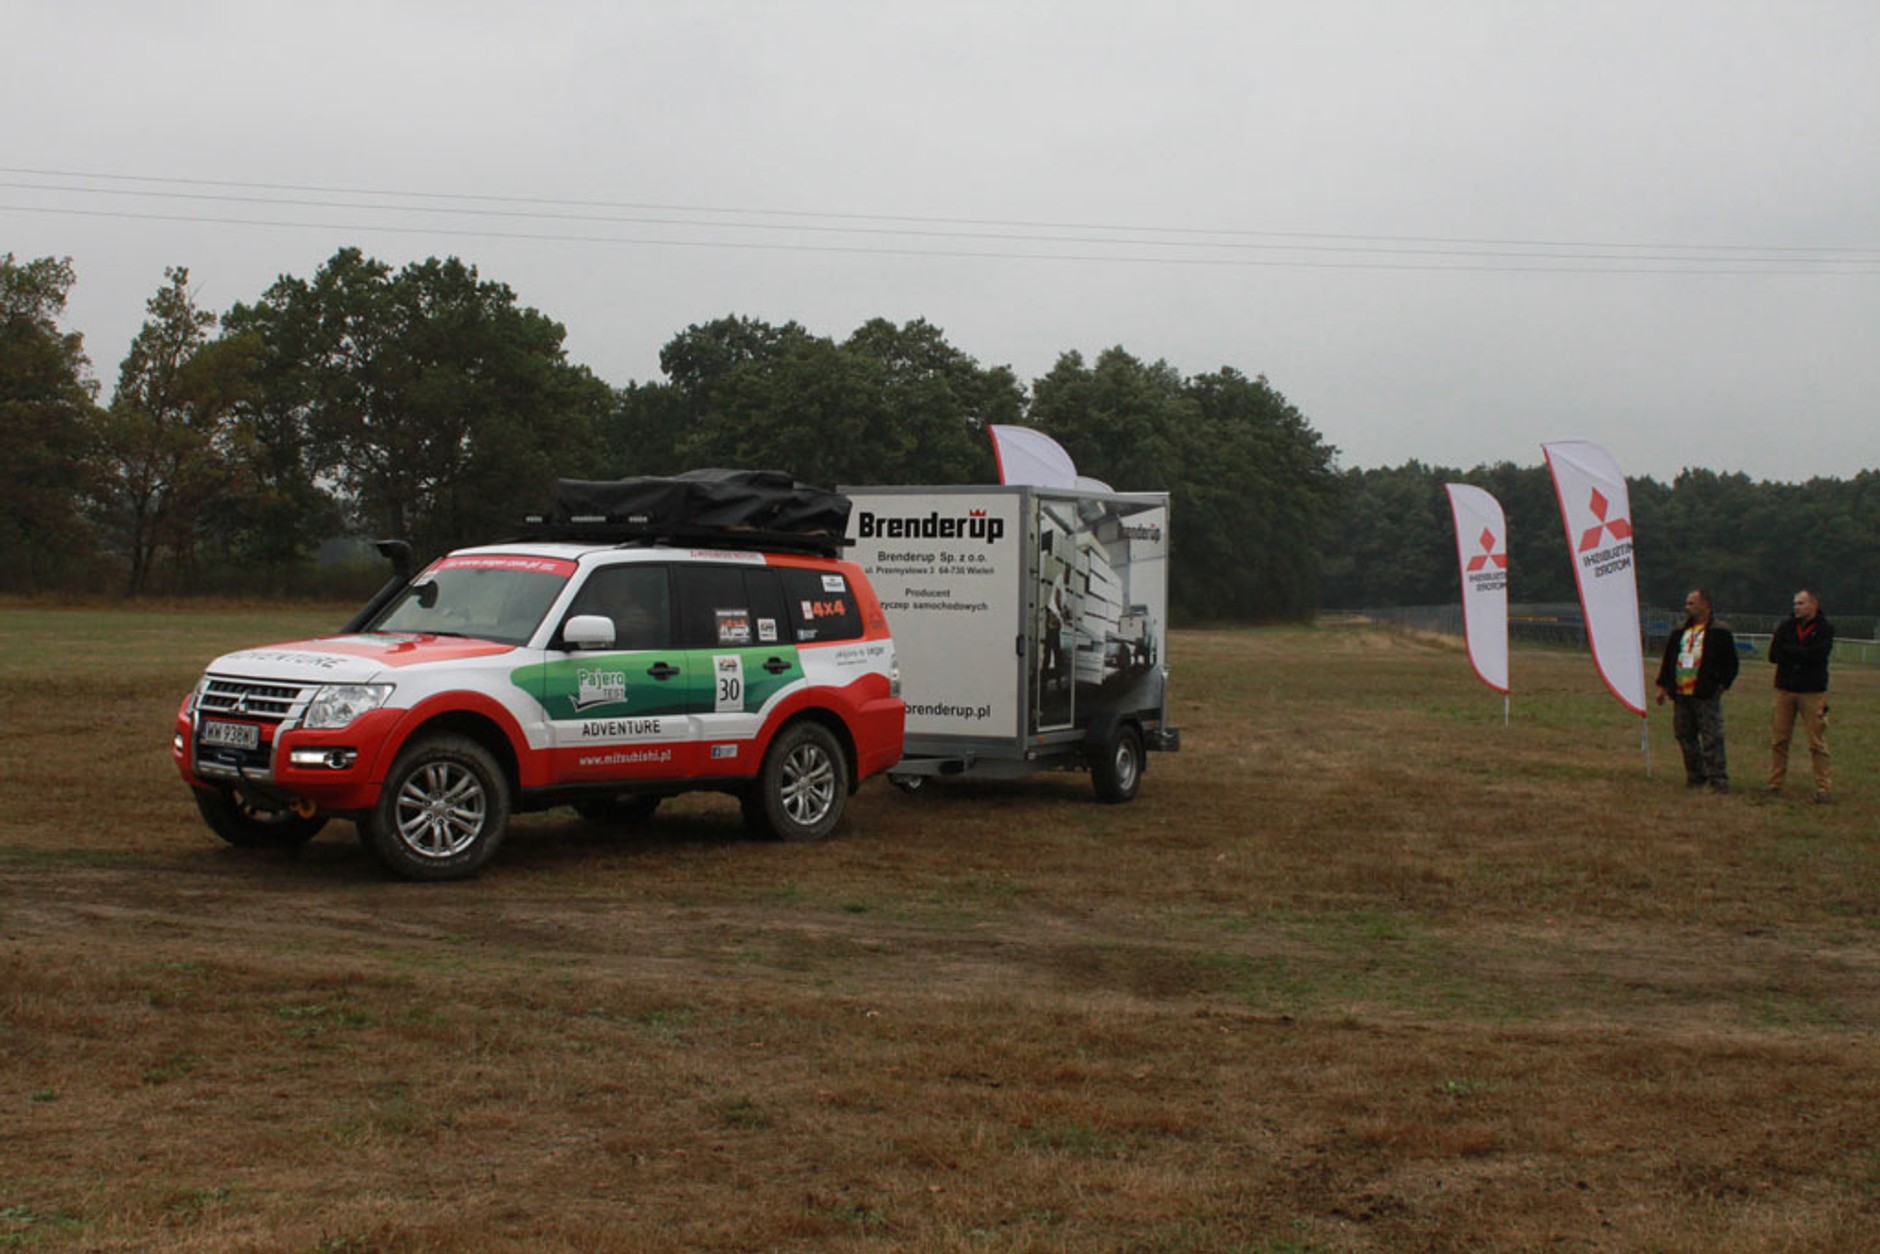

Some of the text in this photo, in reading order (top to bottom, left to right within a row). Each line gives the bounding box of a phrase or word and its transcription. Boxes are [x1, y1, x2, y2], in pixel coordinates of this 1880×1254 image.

[859, 512, 1004, 544] Brenderup
[877, 551, 935, 563] Brenderup
[940, 551, 955, 563] Sp.
[960, 554, 965, 562] z
[905, 588, 950, 598] Producent
[813, 600, 846, 617] 4x4
[913, 601, 988, 612] samochodowych
[578, 670, 624, 689] Pajero
[603, 688, 625, 698] TEST
[720, 678, 740, 701] 30
[582, 719, 661, 736] ADVENTURE
